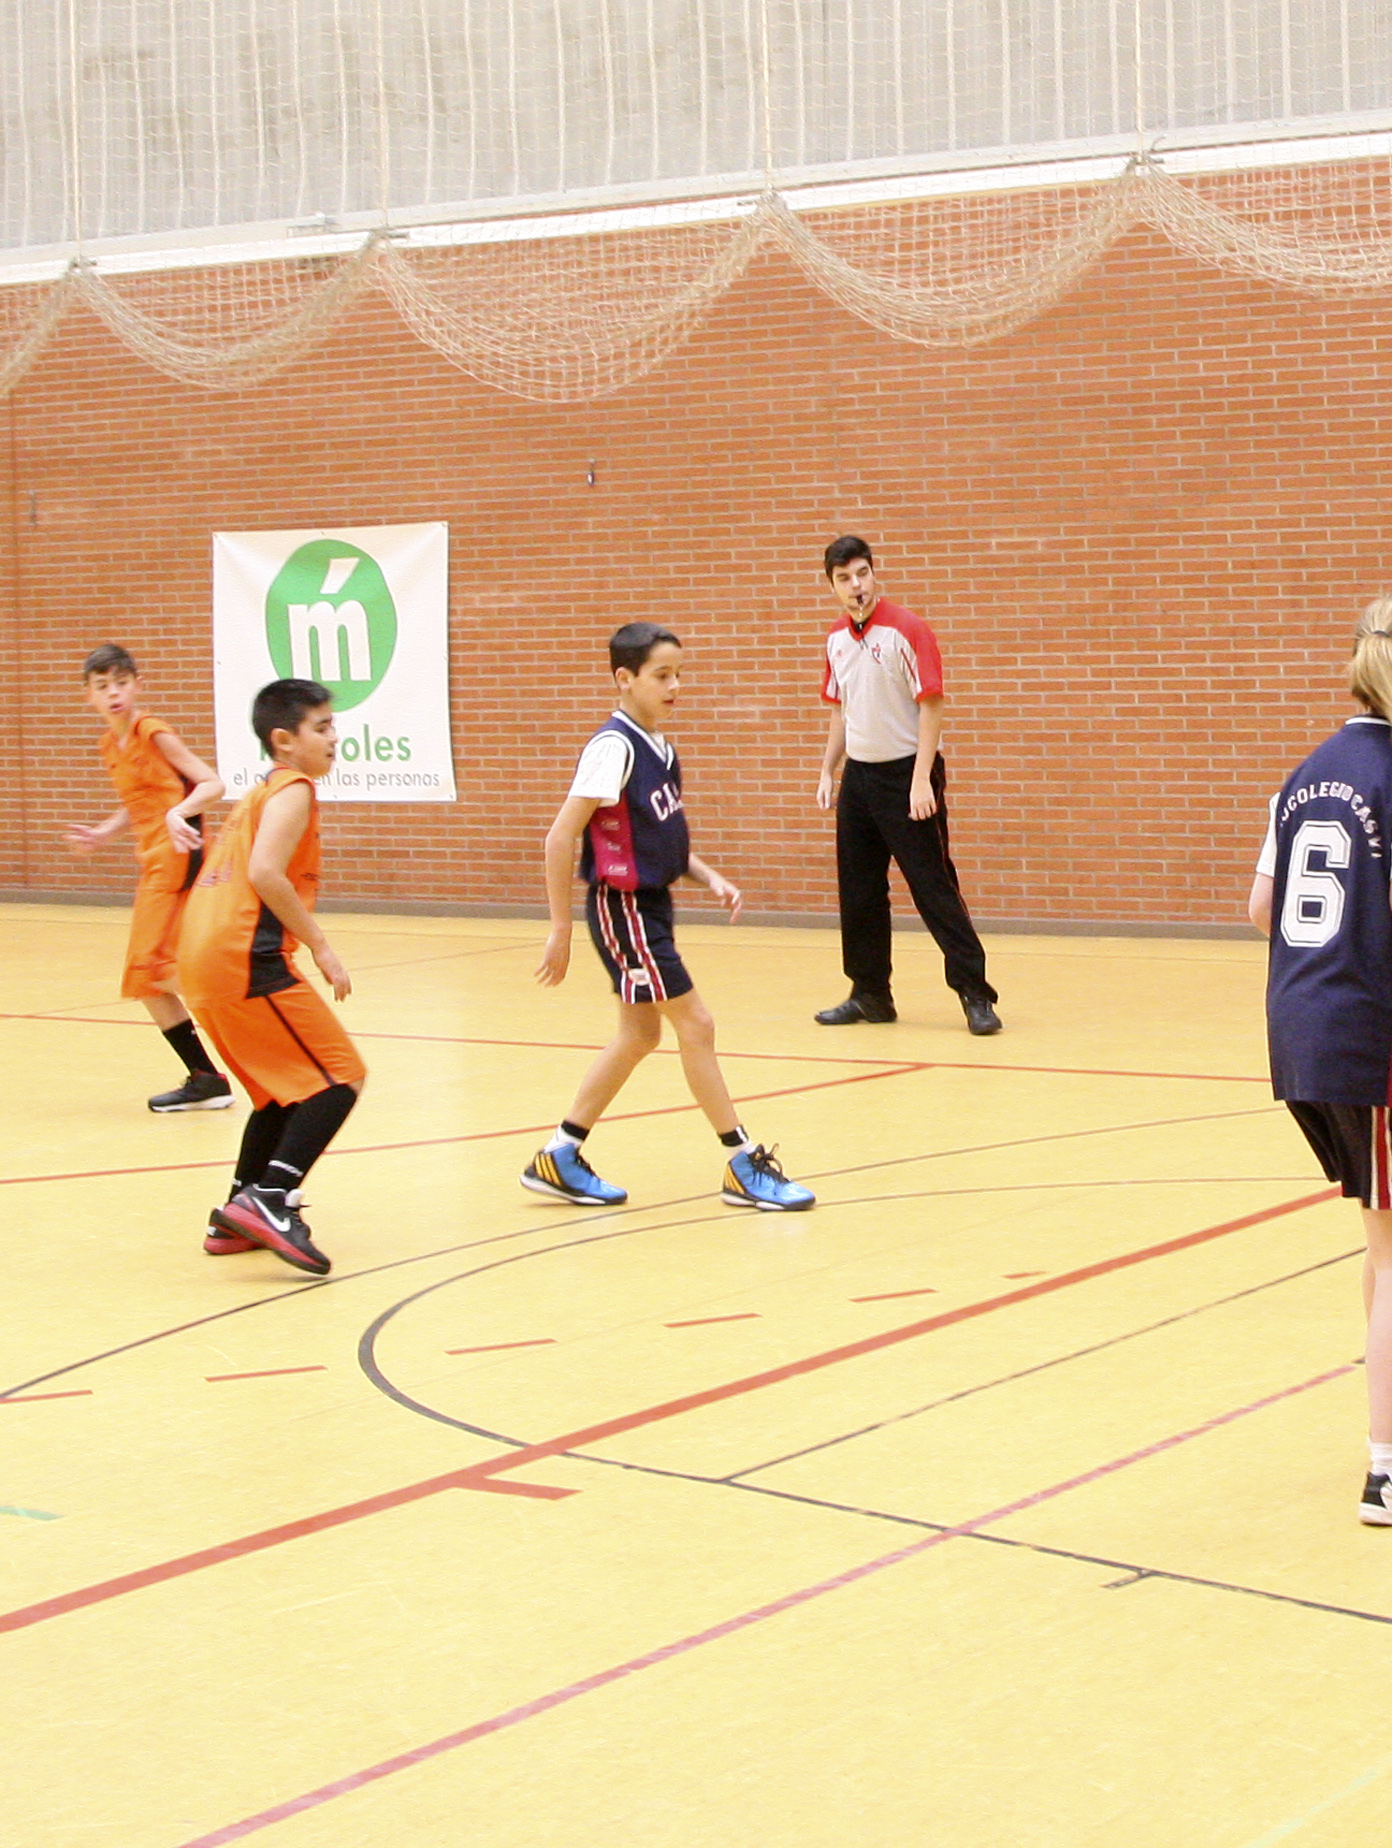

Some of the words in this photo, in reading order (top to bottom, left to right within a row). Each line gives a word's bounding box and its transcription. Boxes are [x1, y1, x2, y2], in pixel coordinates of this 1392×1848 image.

[233, 767, 248, 786] el
[336, 767, 361, 787] las
[366, 772, 440, 791] personas
[1280, 819, 1352, 948] 6
